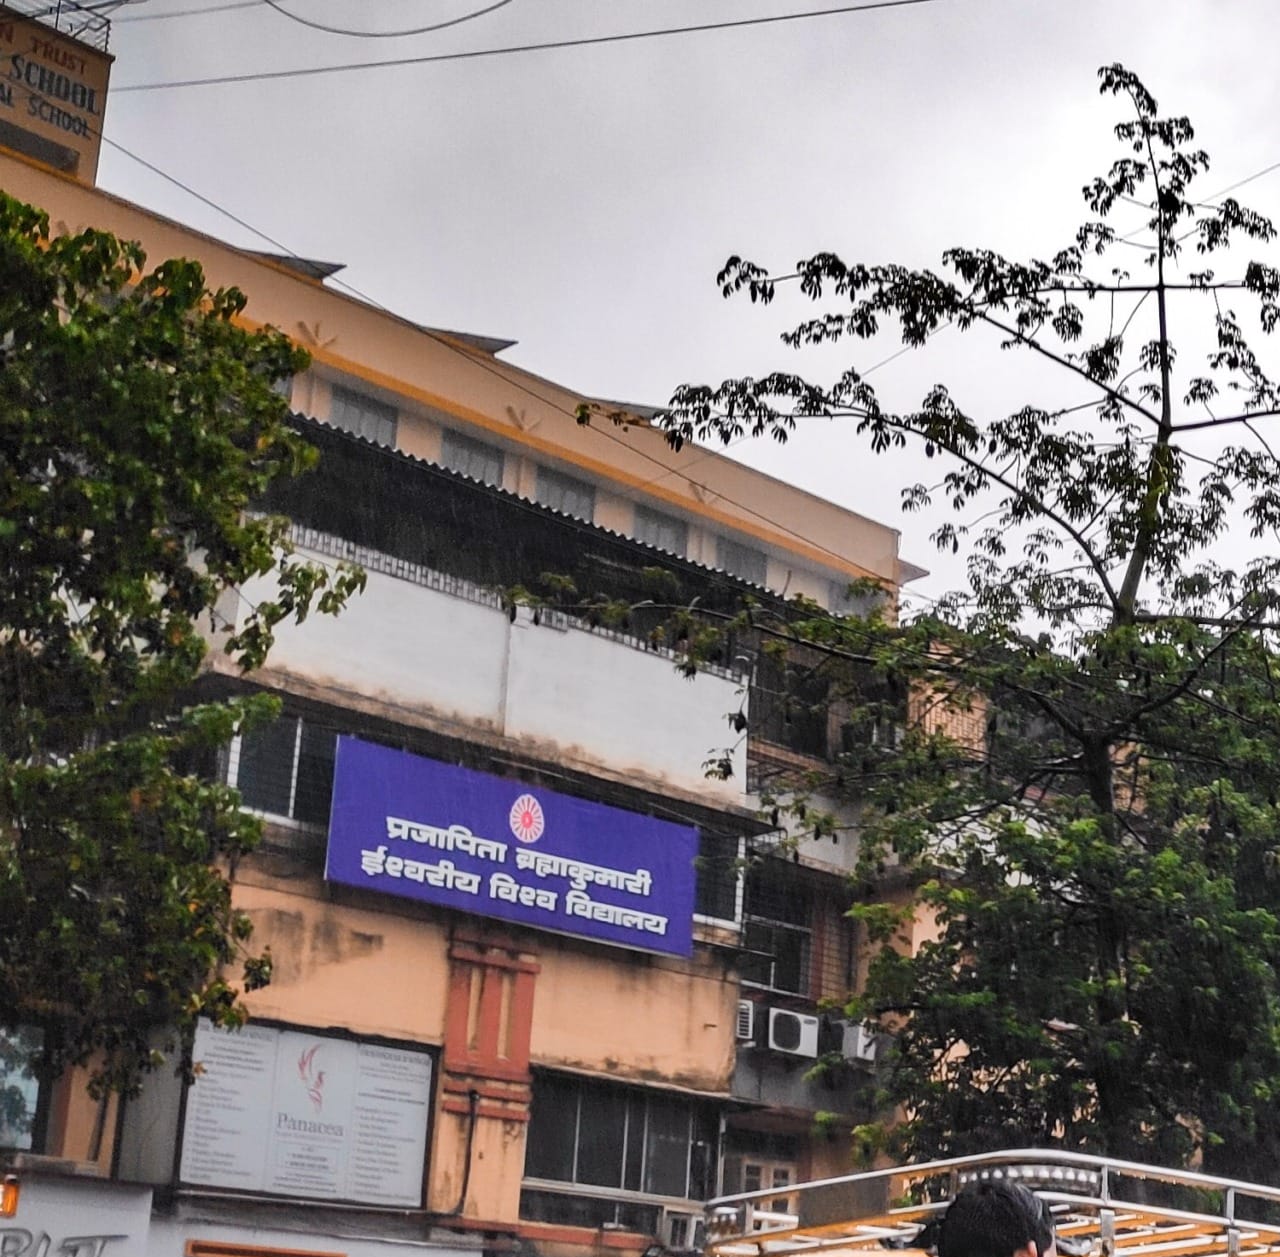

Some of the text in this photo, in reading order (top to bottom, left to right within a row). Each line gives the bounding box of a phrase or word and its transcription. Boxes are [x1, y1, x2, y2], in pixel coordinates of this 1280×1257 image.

[31, 35, 87, 74] TRUST
[11, 53, 100, 117] SCHOOL
[28, 93, 92, 140] SCHOOL
[386, 816, 652, 896] प्रजापिता ब्रह्माकुमारी
[361, 845, 668, 935] ईश्वरीय विश्व विद्यालय
[277, 1111, 344, 1137] Panacea
